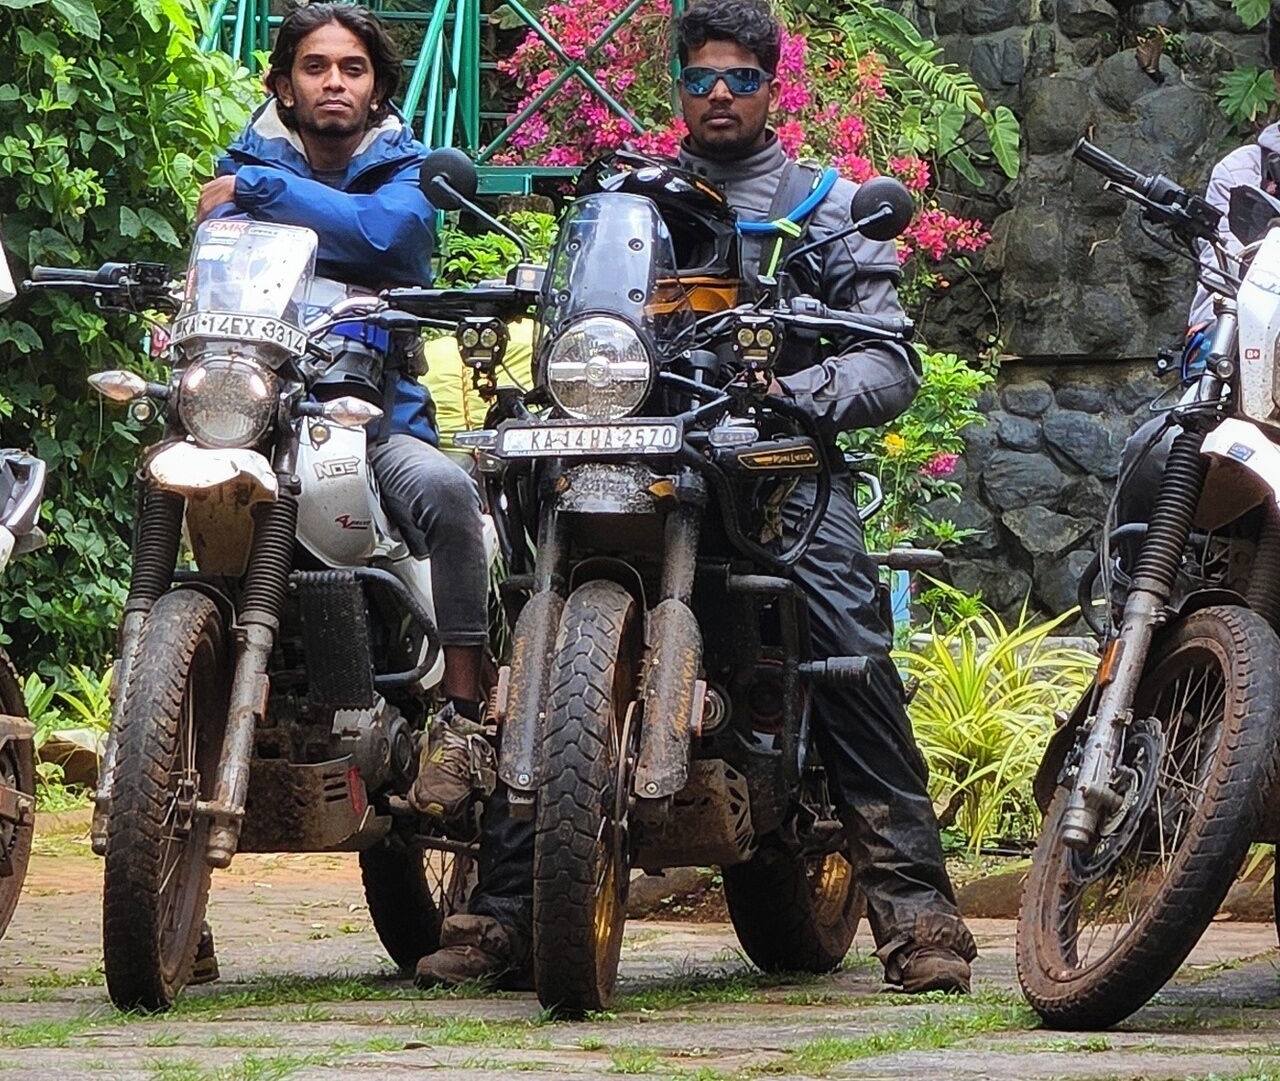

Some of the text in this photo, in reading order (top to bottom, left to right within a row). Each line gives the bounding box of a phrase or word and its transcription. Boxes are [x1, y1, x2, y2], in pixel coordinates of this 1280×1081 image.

[182, 317, 303, 352] KA 14EX 3314
[531, 430, 552, 450] KA
[622, 428, 671, 448] 2570
[313, 455, 361, 480] NOS
[676, 647, 695, 736] HIMALAYAN
